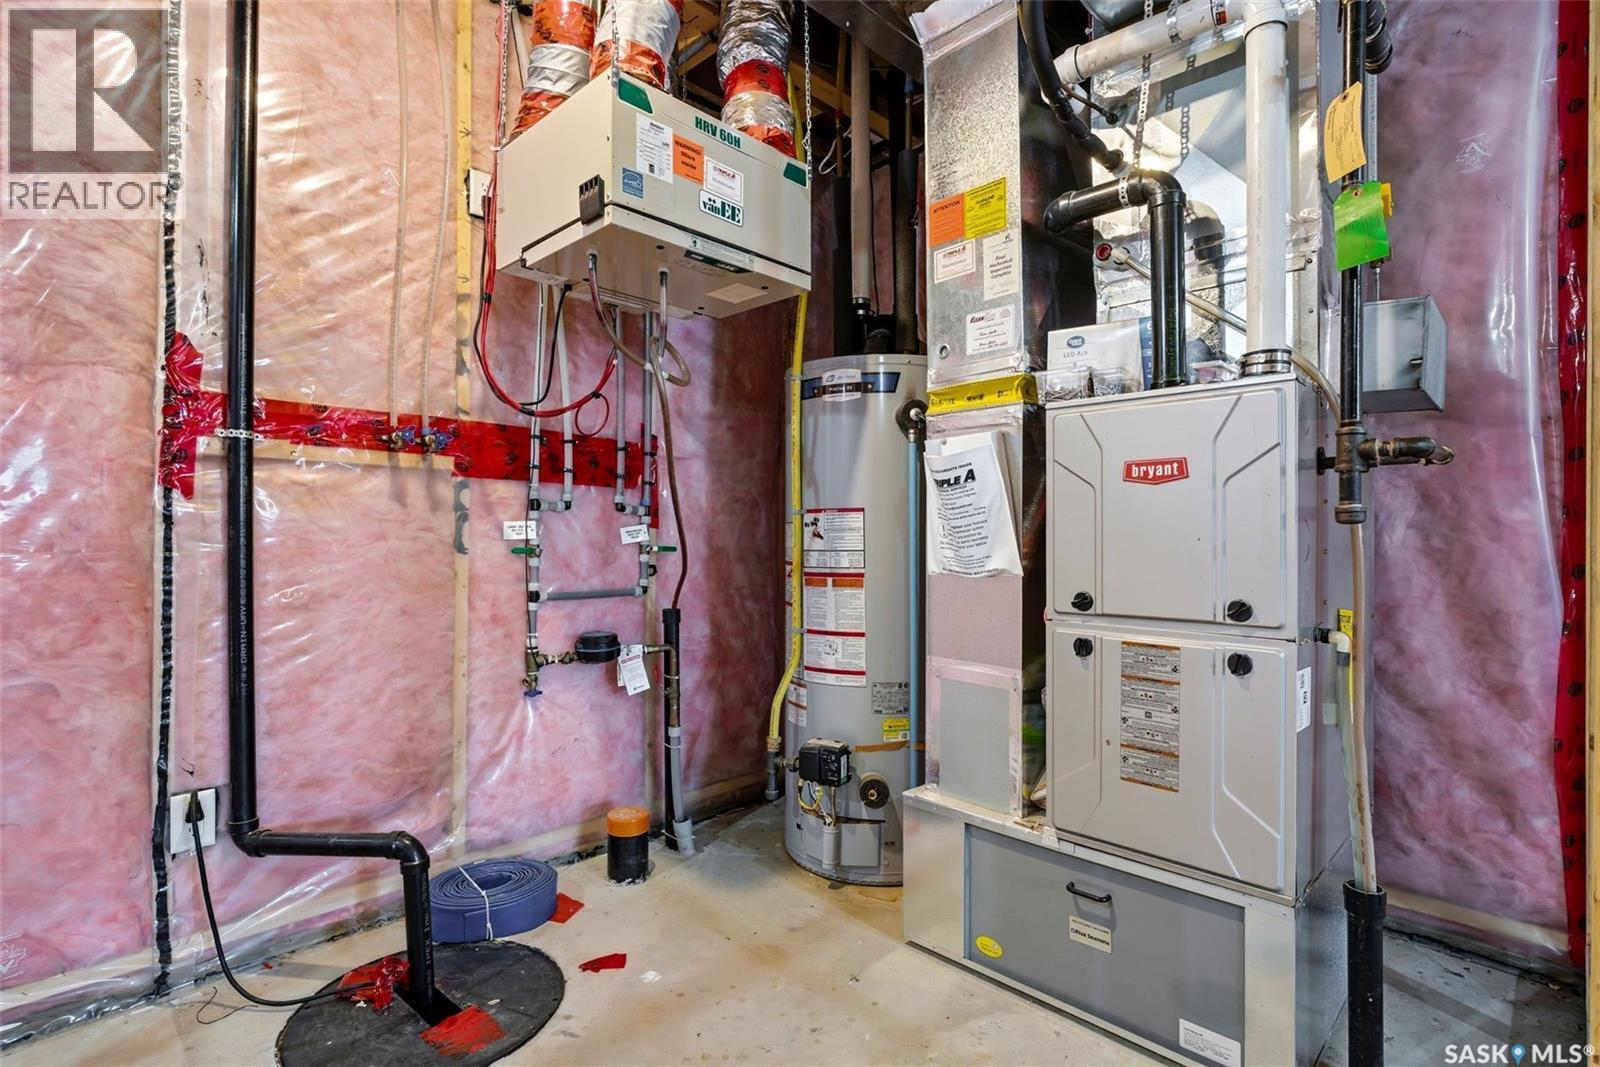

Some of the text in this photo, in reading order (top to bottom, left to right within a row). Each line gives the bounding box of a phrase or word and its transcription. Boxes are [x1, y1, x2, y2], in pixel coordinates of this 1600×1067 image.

[695, 116, 741, 149] HRV 60H
[702, 197, 741, 224] vänEE
[963, 468, 976, 483] A
[1131, 462, 1179, 479] bryant
[1075, 929, 1111, 946] Five Seasons
